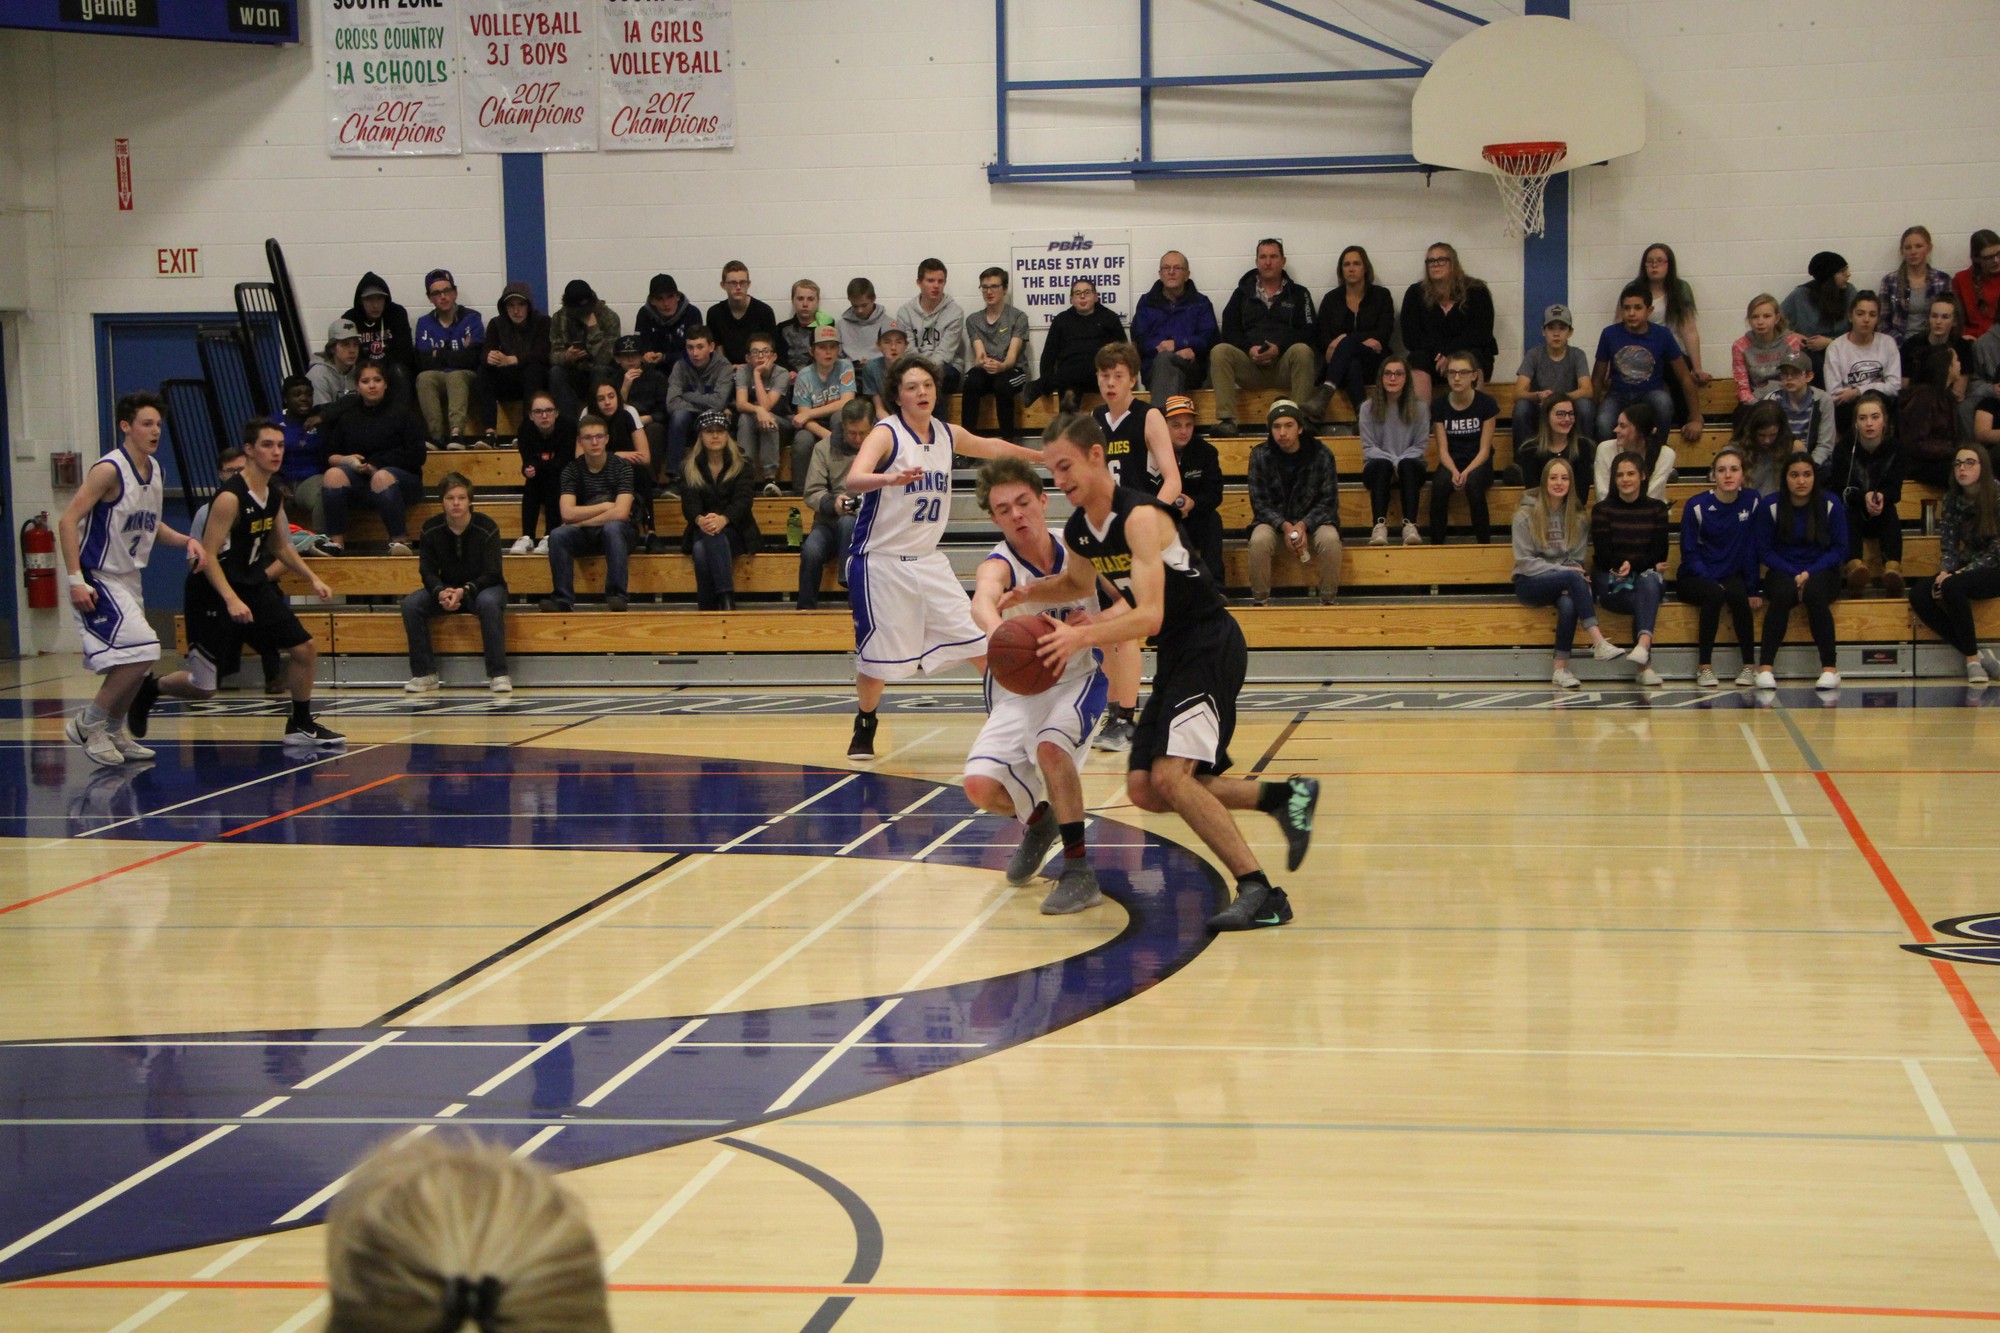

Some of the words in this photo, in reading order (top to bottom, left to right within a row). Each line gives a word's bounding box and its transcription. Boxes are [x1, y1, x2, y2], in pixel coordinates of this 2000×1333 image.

[81, 0, 137, 21] game
[239, 6, 281, 28] won
[469, 11, 582, 36] VOLLEYBALL
[335, 27, 379, 50] CROSS
[384, 26, 445, 50] COUNTRY
[623, 20, 642, 43] 1A
[650, 20, 704, 43] GIRLS
[486, 41, 510, 66] 3J
[520, 41, 568, 65] BOYS
[609, 50, 723, 75] VOLLEYBALL
[336, 60, 355, 85] 1A
[363, 59, 448, 84] SCHOOLS
[511, 81, 561, 104] 2017
[645, 91, 696, 114] 2017
[373, 101, 424, 122] 2017
[478, 95, 585, 133] Champions
[339, 112, 446, 151] Champions
[611, 105, 719, 143] Champions
[1047, 240, 1094, 252] PBHS
[157, 248, 199, 274] EXIT
[1016, 258, 1062, 271] PLEASE
[1066, 257, 1100, 270] STAY
[1104, 256, 1126, 269] OFF
[1022, 276, 1045, 289] THE
[1026, 293, 1066, 306] WHEN
[1451, 417, 1481, 431] NEED
[1107, 440, 1130, 455] ADES
[911, 496, 942, 523] 20
[121, 509, 158, 534] KINGS
[128, 534, 142, 557] 2
[1235, 689, 1742, 711] KING
